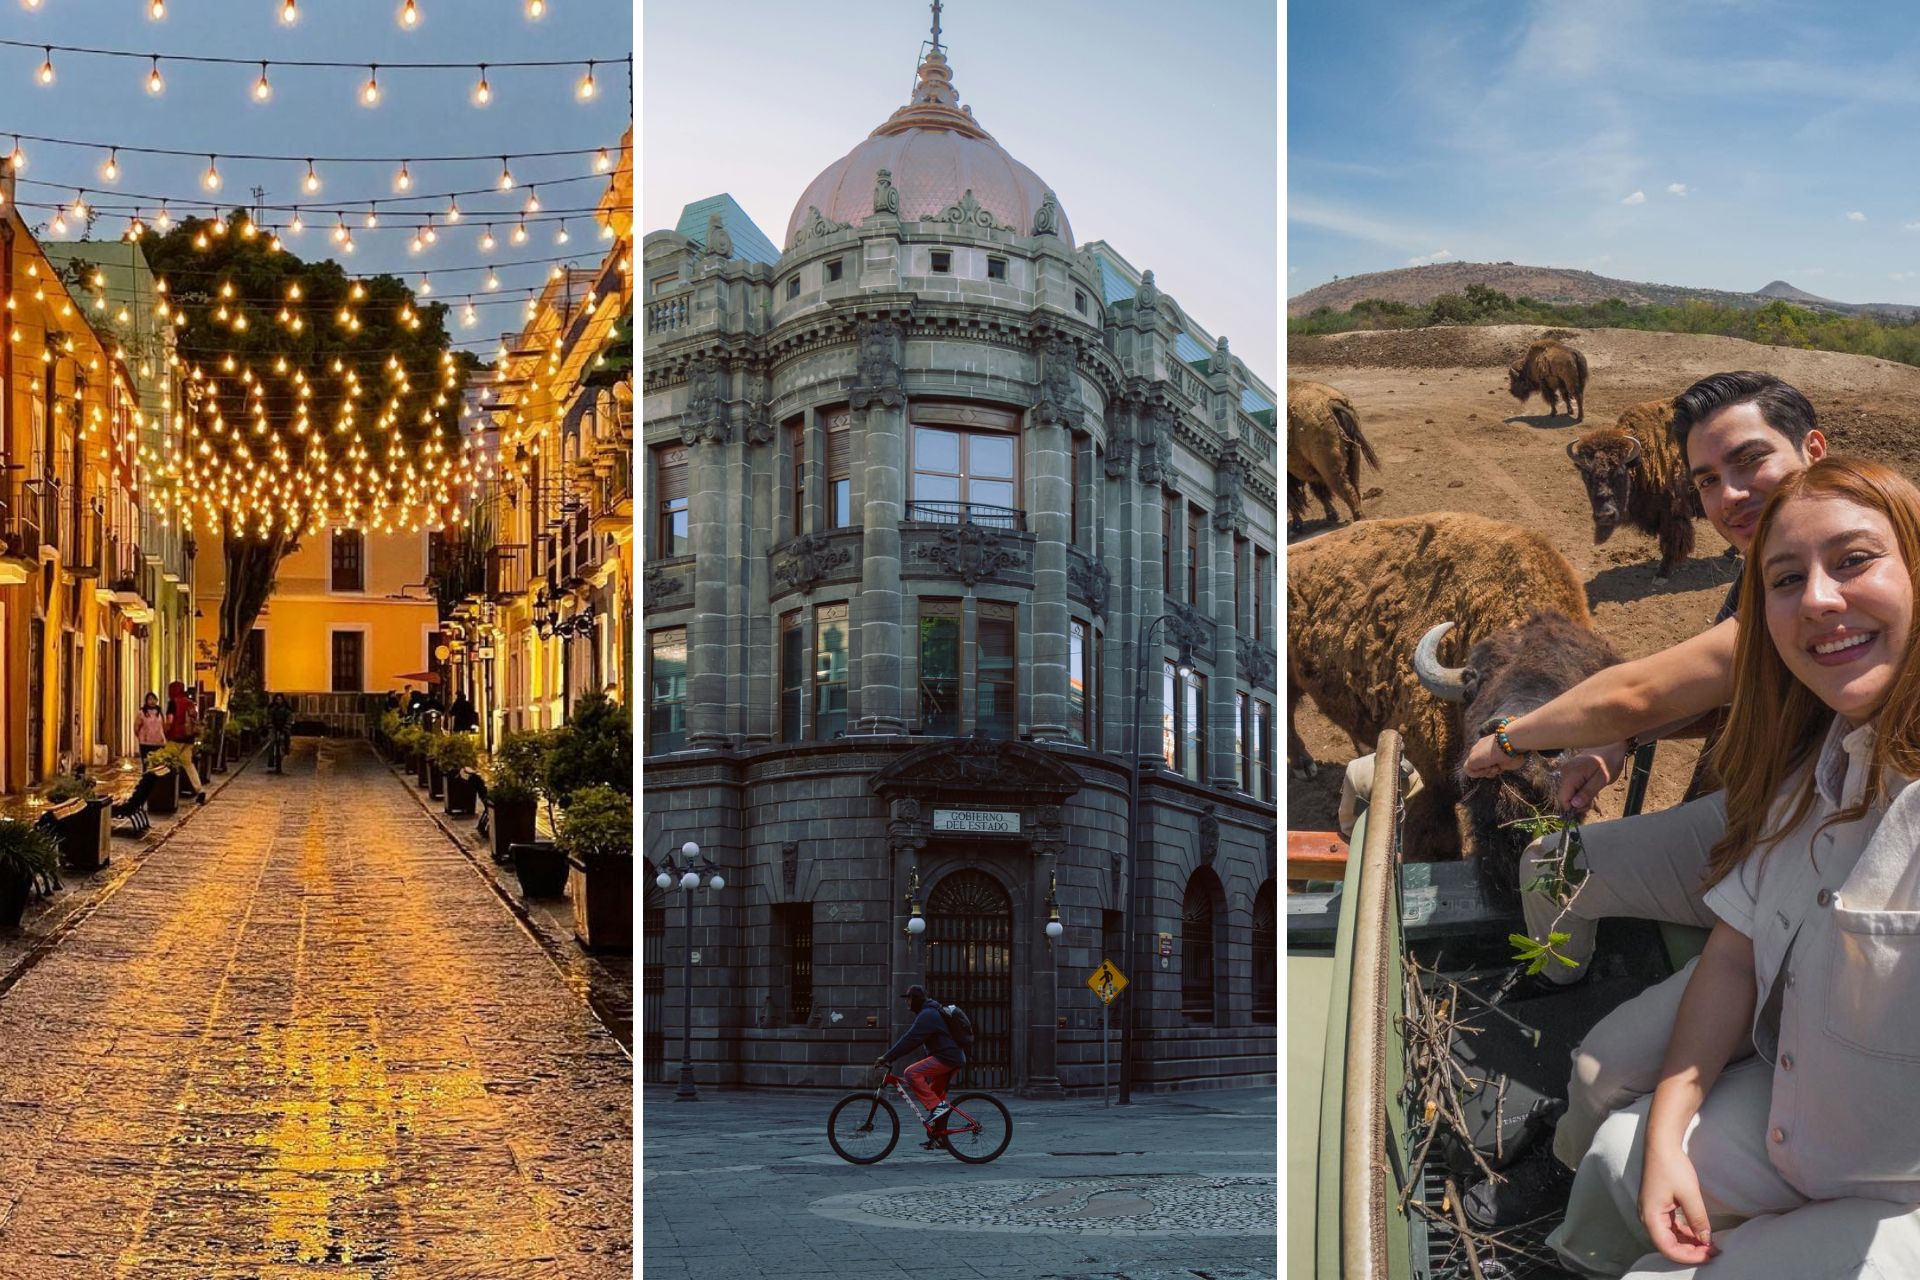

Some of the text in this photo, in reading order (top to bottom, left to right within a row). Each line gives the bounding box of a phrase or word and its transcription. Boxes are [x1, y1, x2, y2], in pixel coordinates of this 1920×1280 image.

[951, 812, 1003, 822] GOBIERNO
[946, 820, 1009, 831] DEL ESTADO
